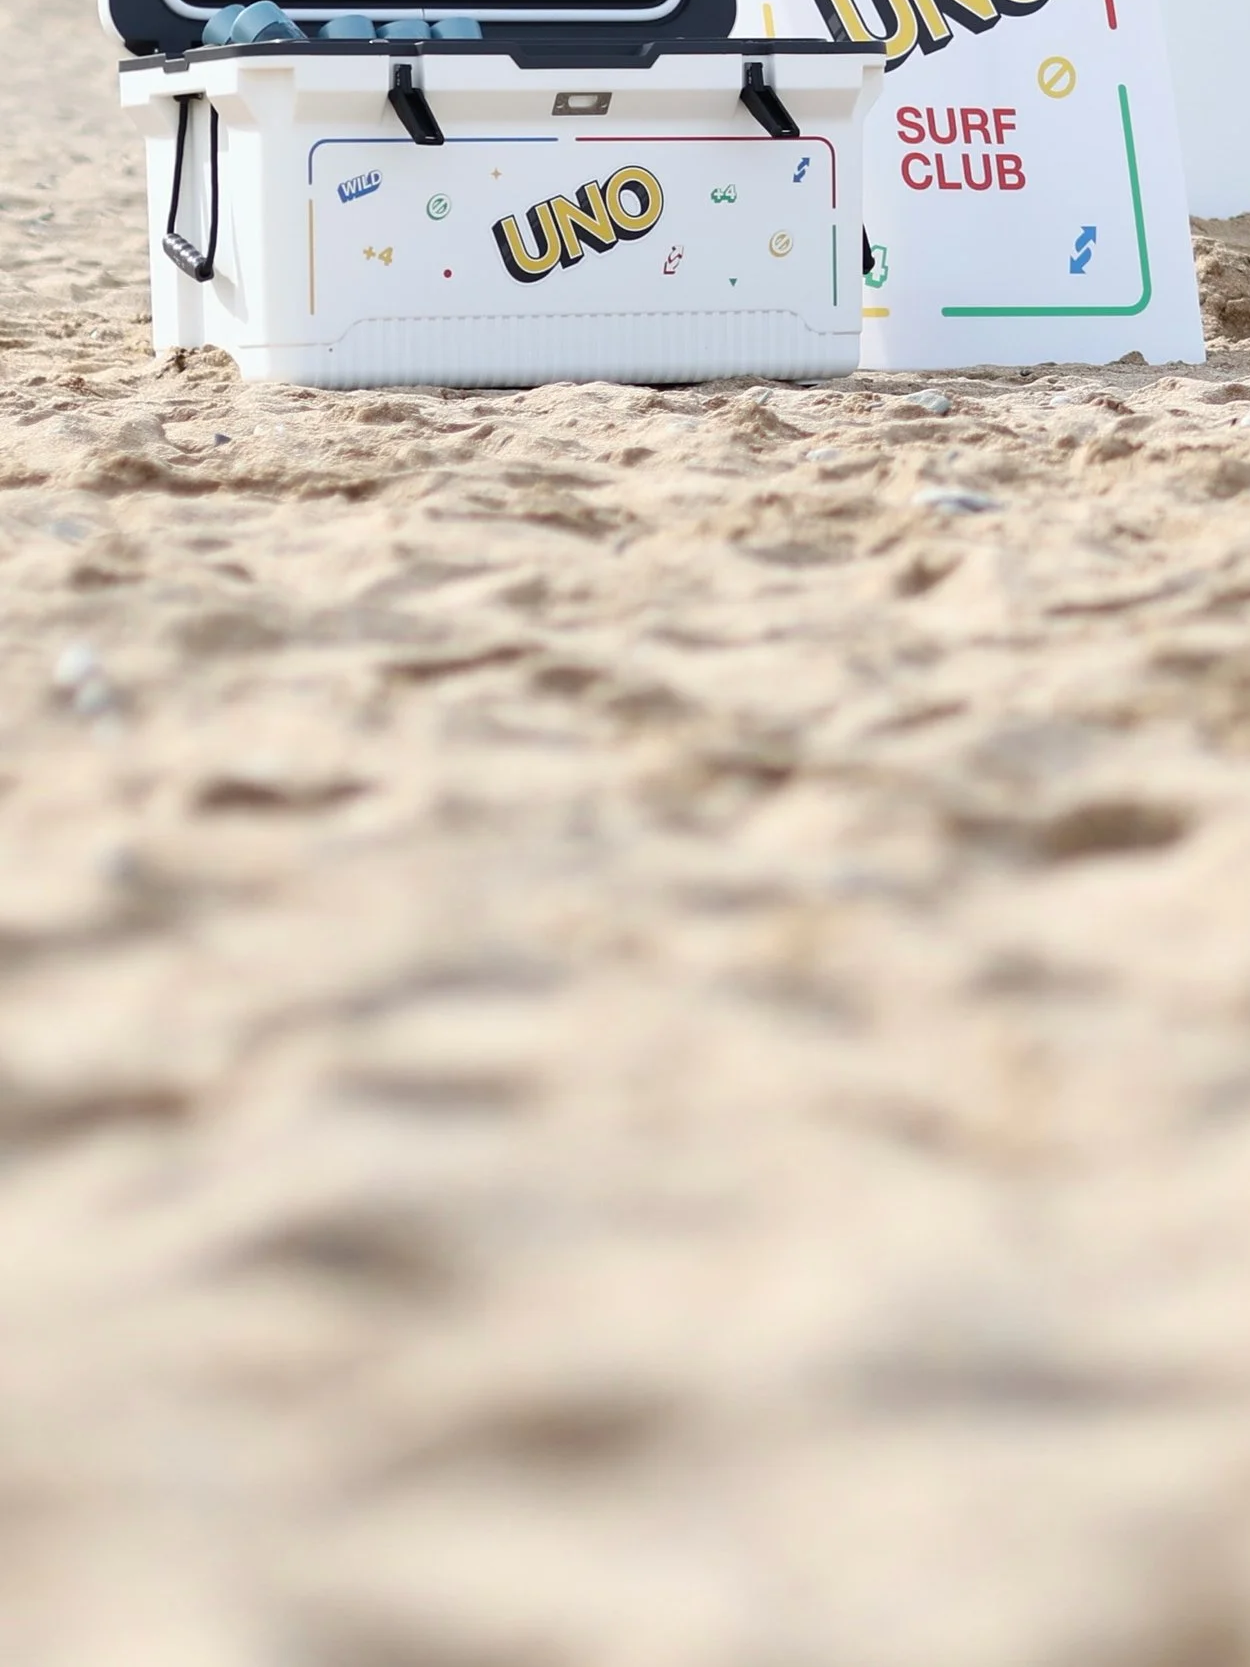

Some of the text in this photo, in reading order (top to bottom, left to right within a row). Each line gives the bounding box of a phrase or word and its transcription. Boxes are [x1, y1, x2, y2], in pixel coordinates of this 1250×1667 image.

[896, 106, 1016, 145] SURF
[338, 169, 382, 203] WILD
[901, 152, 1026, 191] CLUB
[492, 165, 664, 283] UNO
[363, 246, 393, 266] +4
